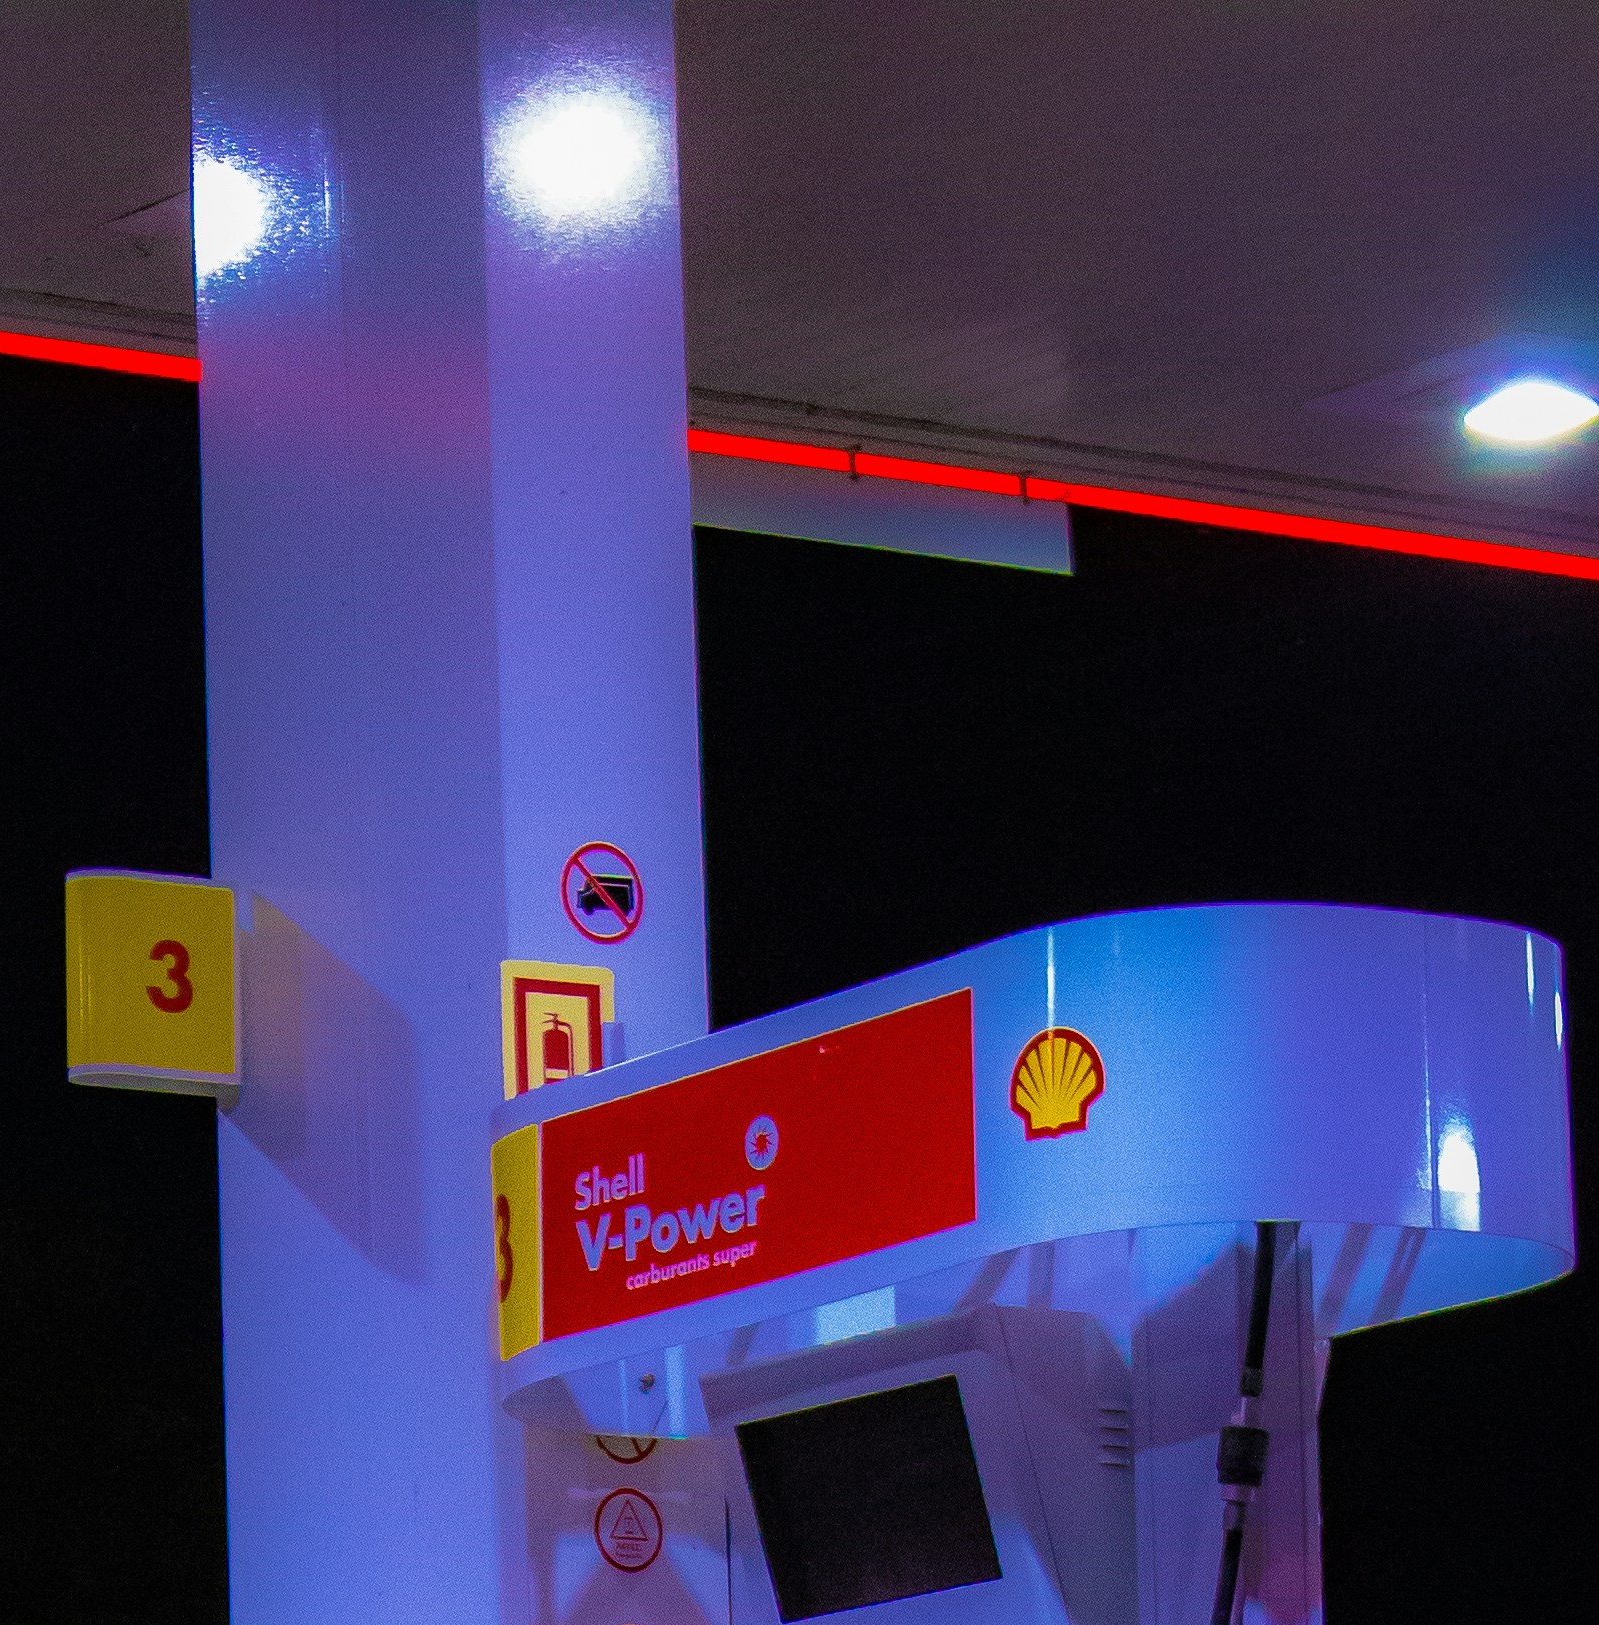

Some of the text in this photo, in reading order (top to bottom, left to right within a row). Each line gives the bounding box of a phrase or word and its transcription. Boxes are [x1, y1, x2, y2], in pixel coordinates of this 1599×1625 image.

[145, 939, 194, 1014] 3
[574, 1152, 646, 1211] Shell
[575, 1184, 766, 1272] V-Power
[625, 1241, 758, 1290] carburants super
